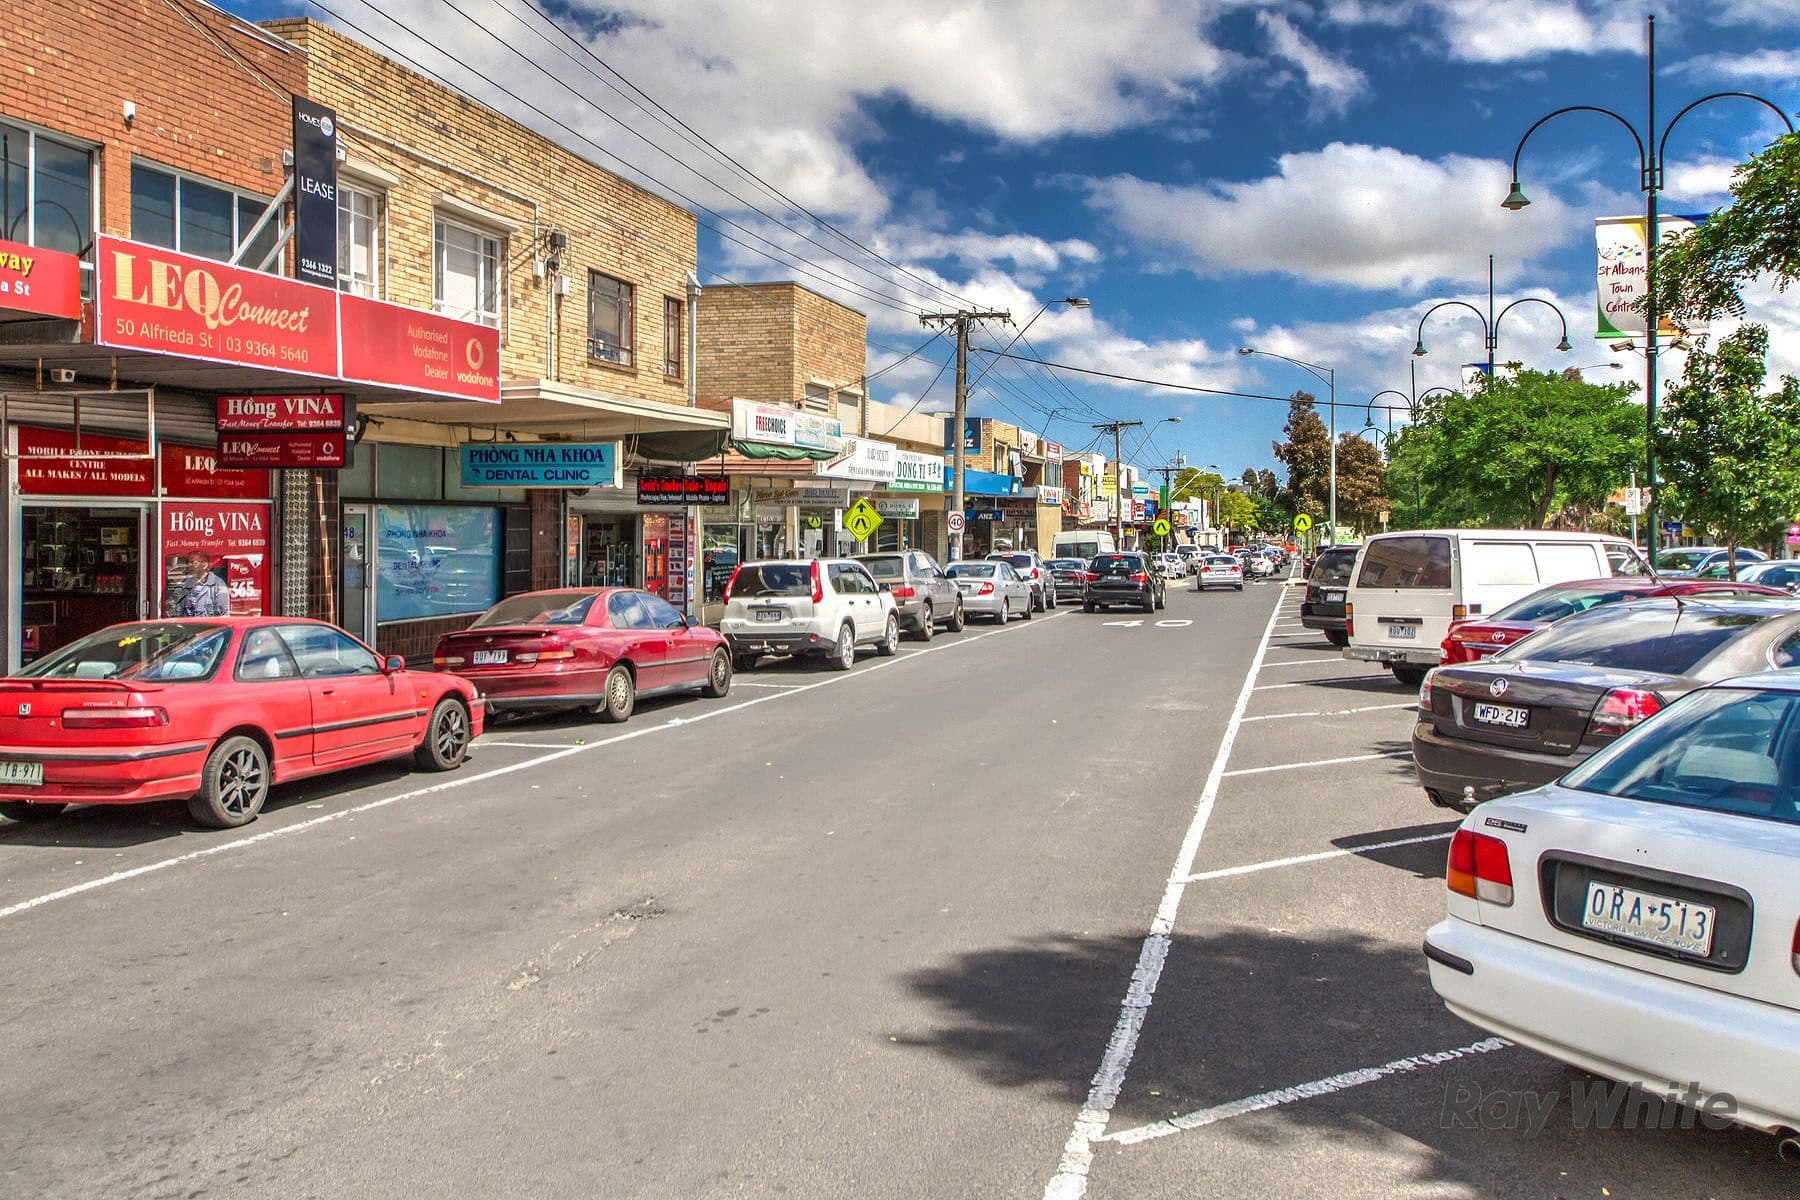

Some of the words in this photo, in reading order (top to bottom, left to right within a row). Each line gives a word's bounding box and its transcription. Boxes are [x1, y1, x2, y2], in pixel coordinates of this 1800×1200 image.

[300, 175, 335, 201] LEASE
[301, 258, 317, 270] 9366
[318, 262, 333, 275] 1322
[1598, 265, 1612, 277] St
[1611, 262, 1646, 276] Albans
[14, 281, 31, 297] St
[111, 250, 220, 330] LEQ
[214, 283, 310, 334] Connect
[1608, 282, 1633, 295] Town
[1605, 300, 1637, 313] Centre
[116, 318, 135, 337] 50
[140, 322, 194, 346] Alfrieda
[198, 331, 214, 348] St
[225, 336, 242, 354] 03
[246, 339, 277, 359] 9364
[279, 344, 309, 364] 5640
[408, 324, 448, 344] Authorised
[412, 343, 448, 362] Vodafone
[424, 364, 448, 380] Dealer
[456, 371, 494, 388] vodafone
[283, 397, 334, 415] VINA
[523, 448, 557, 463] NHA
[561, 448, 604, 463] KHOA
[69, 459, 106, 470] CENTRE
[897, 460, 917, 480] DONG
[25, 469, 45, 479] ALL
[47, 469, 82, 480] MAKES
[89, 471, 107, 481] ALL
[110, 472, 146, 482] MODELS
[485, 468, 539, 480] DENTAL
[543, 469, 591, 481] CLINIC
[217, 512, 262, 532] VINA
[950, 517, 962, 527] 40
[230, 580, 254, 599] 365
[1589, 918, 1627, 934] VICTORIA
[1671, 938, 1703, 952] MOVE
